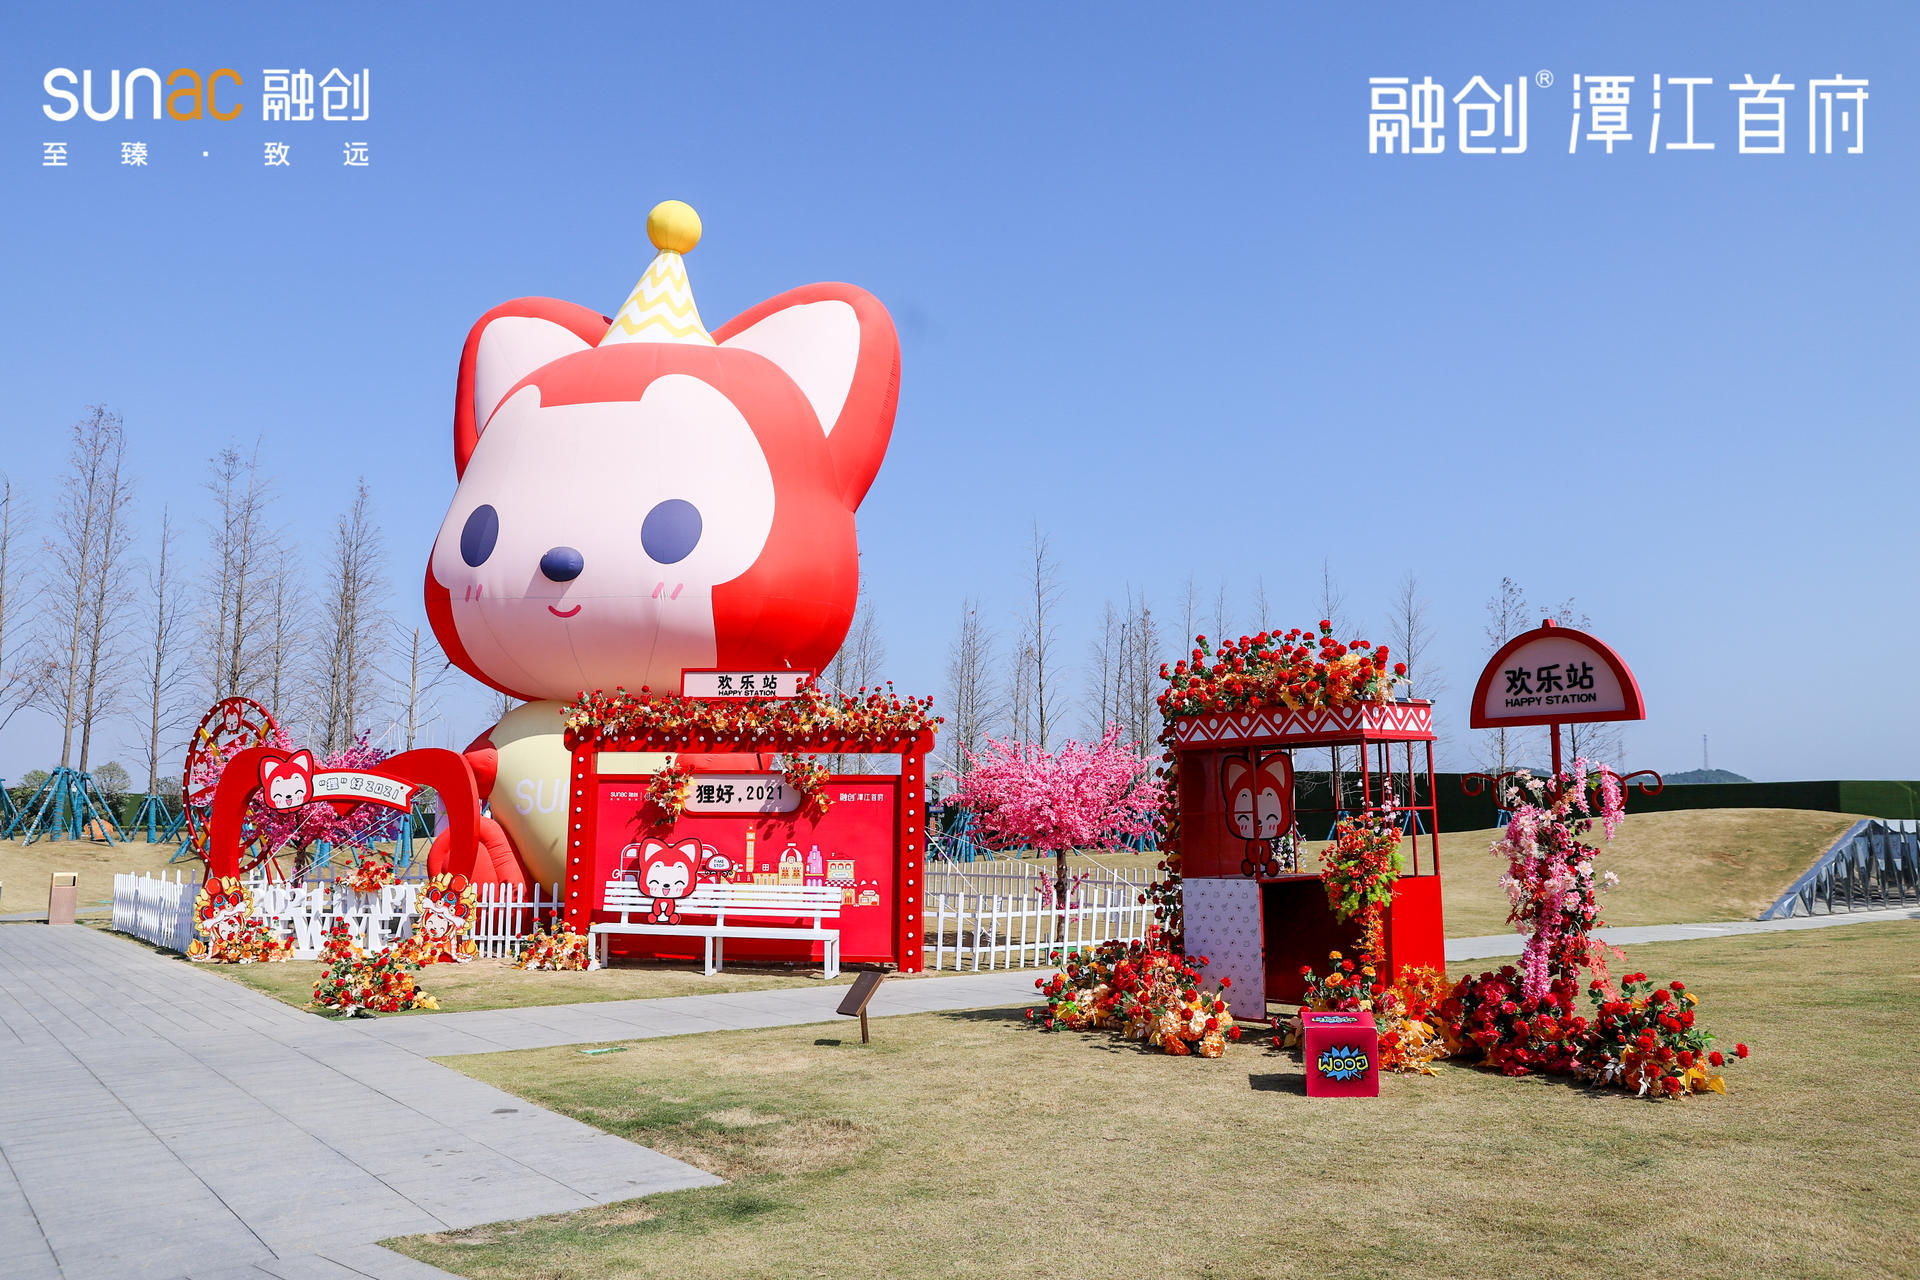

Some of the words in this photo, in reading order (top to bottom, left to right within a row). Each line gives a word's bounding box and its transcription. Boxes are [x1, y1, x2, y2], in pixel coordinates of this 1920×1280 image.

[717, 674, 778, 690] 欢乐站
[1504, 661, 1595, 696] 欢乐站
[1505, 696, 1542, 708] HAPPY
[1545, 692, 1597, 705] STATION
[333, 884, 422, 914] HAPP
